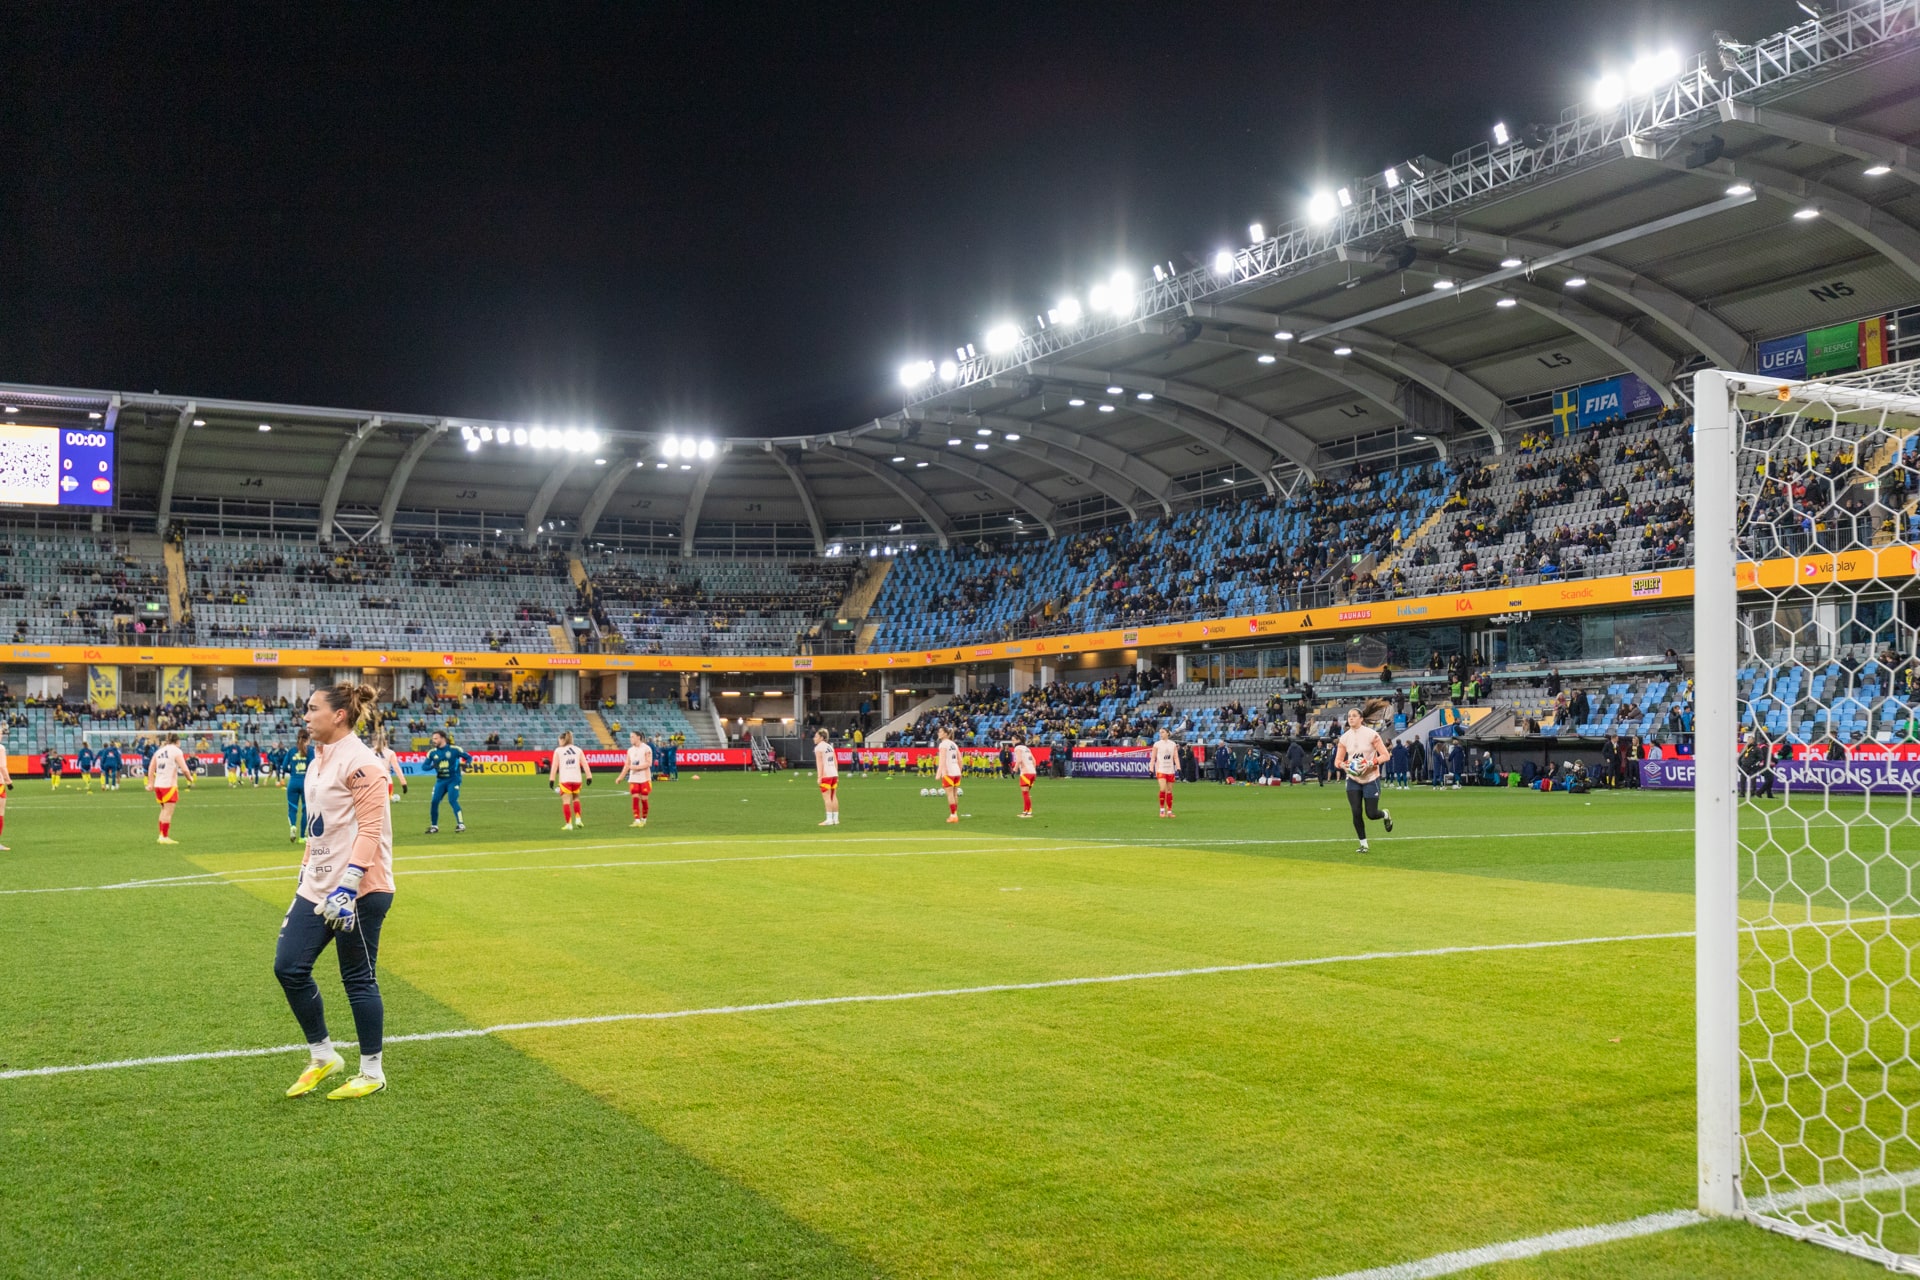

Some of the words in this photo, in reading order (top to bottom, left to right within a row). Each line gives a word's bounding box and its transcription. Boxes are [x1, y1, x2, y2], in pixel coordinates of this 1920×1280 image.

[1809, 281, 1854, 302] N5
[1823, 340, 1854, 353] RESPECT
[1537, 353, 1572, 368] L5
[1762, 348, 1804, 369] UEFA
[1585, 392, 1619, 414] FIFA
[1338, 404, 1369, 418] L4
[65, 432, 106, 447] 00:00
[63, 458, 73, 470] 0
[98, 460, 108, 472] 0
[1820, 559, 1856, 574] viaplay
[1633, 577, 1660, 591] SPORT
[1560, 587, 1593, 600] Scandic
[1397, 605, 1427, 616] Folksam
[1456, 599, 1473, 612] ICA
[1339, 610, 1371, 620] BAUHAUS
[84, 650, 101, 659] ICA
[687, 752, 725, 762] FOTBOLL
[1086, 762, 1120, 773] WOMEN'S
[1665, 766, 1696, 782] UEF
[1790, 767, 1873, 785] NATIONS
